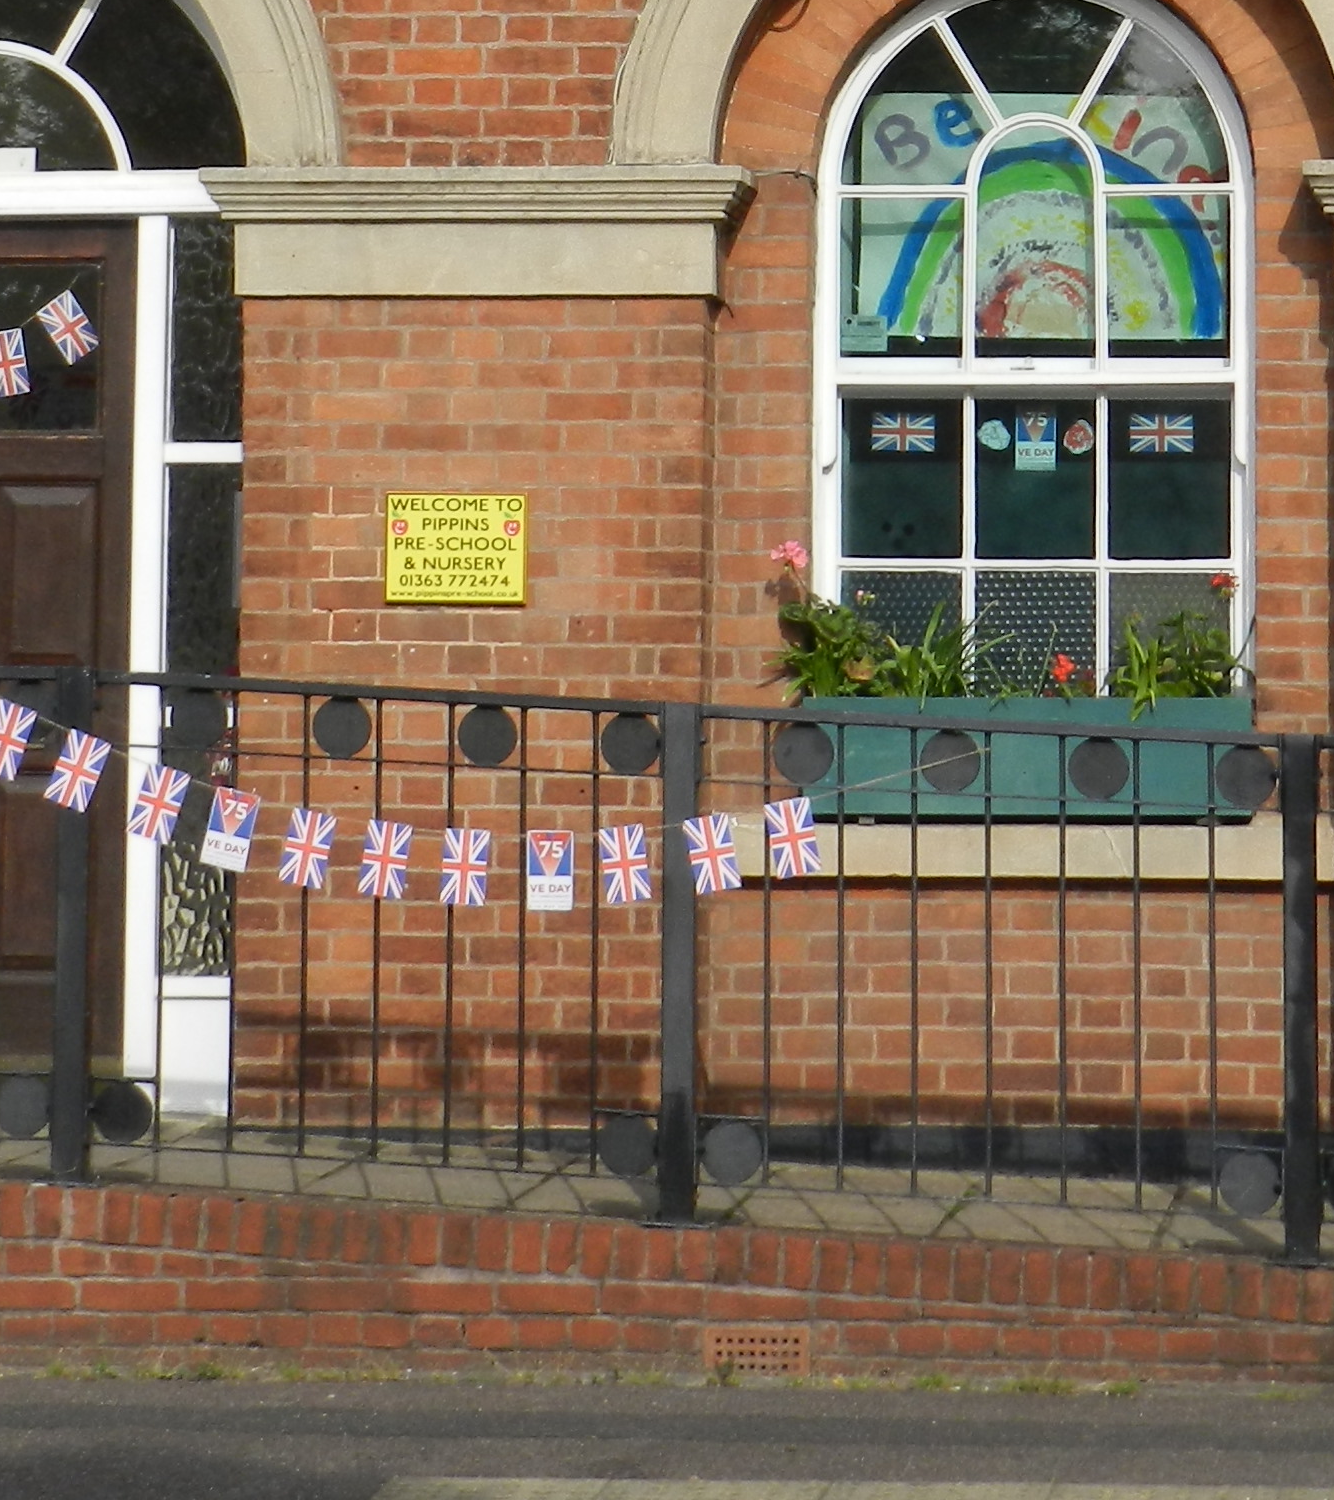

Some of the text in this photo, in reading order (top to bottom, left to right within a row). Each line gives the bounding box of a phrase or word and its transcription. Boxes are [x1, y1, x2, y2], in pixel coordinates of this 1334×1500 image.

[390, 498, 523, 512] WELCOME TO
[422, 518, 490, 531] PIPPINS
[404, 557, 506, 570] & NURSERY
[399, 574, 510, 587] 01363 772474
[223, 799, 248, 821] 75
[207, 839, 247, 855] VE DAY
[538, 840, 564, 859] 75
[530, 884, 572, 893] VE DAY
